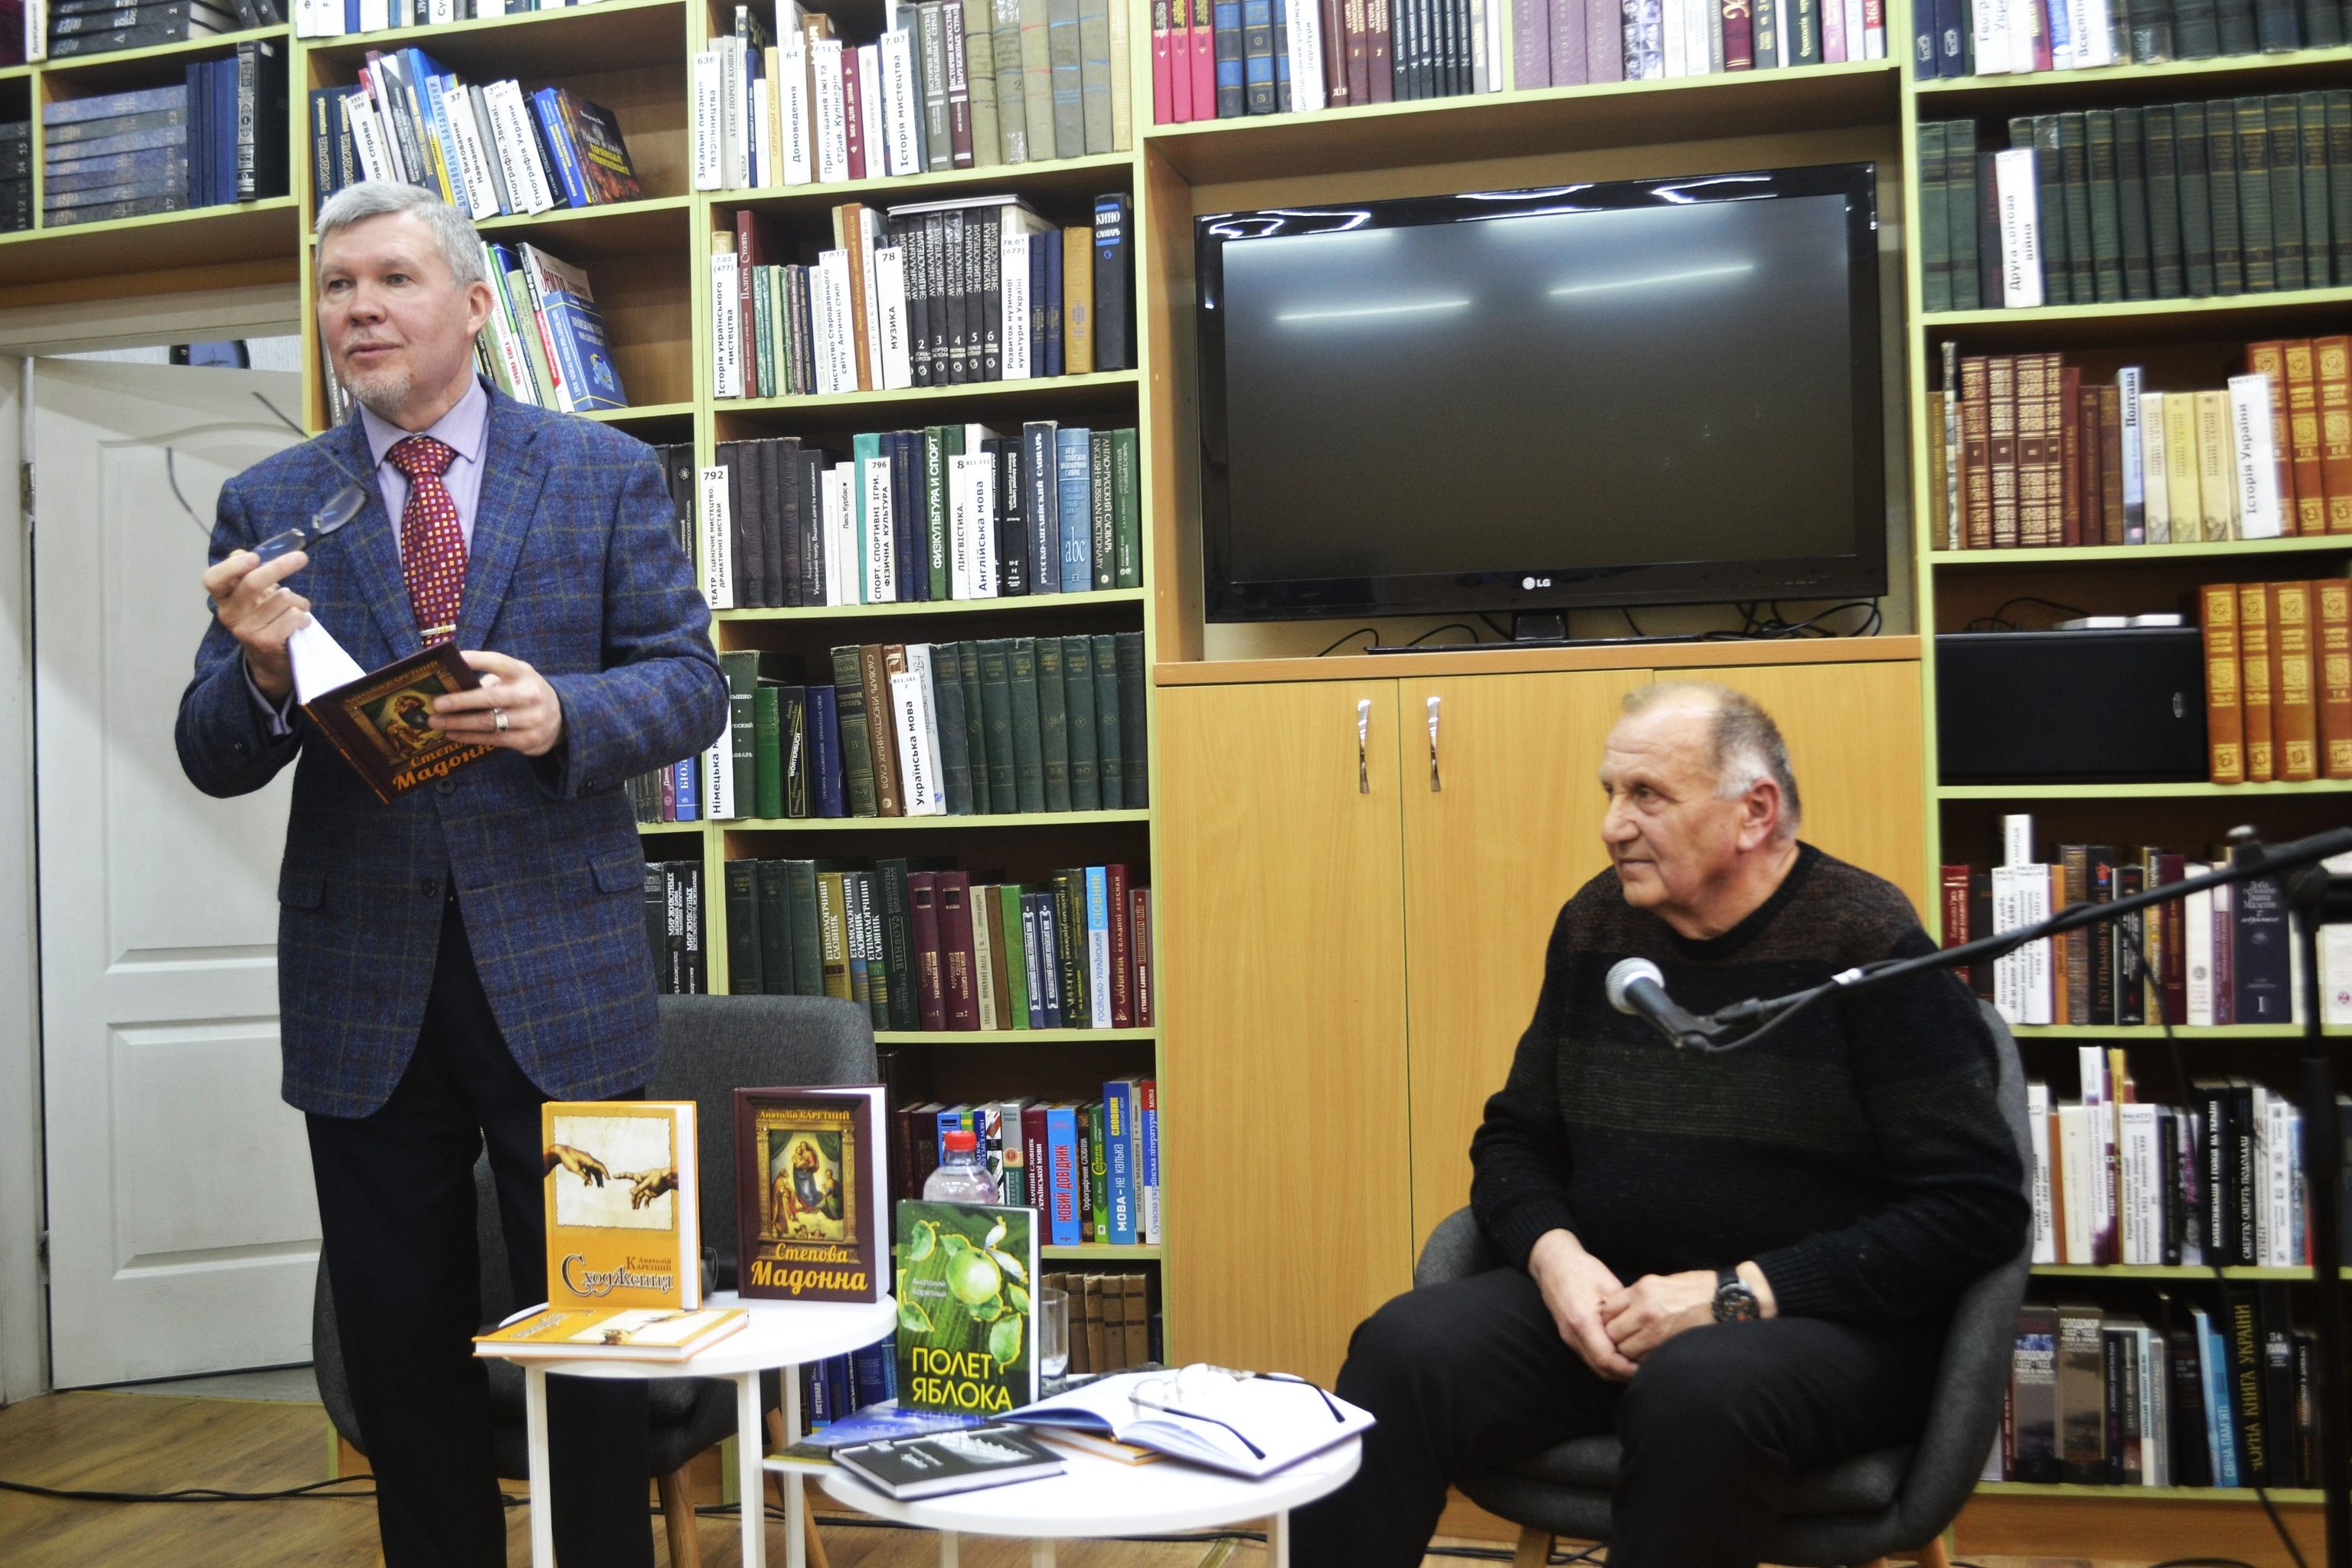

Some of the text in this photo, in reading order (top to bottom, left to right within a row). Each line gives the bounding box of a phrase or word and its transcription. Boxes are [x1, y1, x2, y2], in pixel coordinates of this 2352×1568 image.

[697, 56, 715, 64] 636
[786, 51, 798, 59] 64
[885, 35, 905, 45] 7.03
[821, 65, 827, 75] та
[430, 82, 450, 139] БАТАЛЬЙОНИ
[450, 93, 460, 103] 37
[894, 55, 909, 167] Історія мистецтва
[362, 120, 377, 158] справа
[792, 86, 802, 162] Домоведення
[823, 99, 833, 175] Приготування
[318, 136, 330, 191] ЮРИДИЧНА
[453, 119, 479, 210] Освіта. Виховання.
[467, 136, 483, 184] Навчання
[501, 144, 522, 207] Етнографія.
[508, 105, 543, 207] Етнографія України
[1096, 211, 1120, 225] КИНО
[882, 253, 895, 262] 78
[908, 232, 918, 299] МУЗЫКАЛЬНАЯ
[916, 231, 926, 299] ЭНЦИКЛОПЕДИЯ
[926, 229, 936, 296] МУЗЫКАЛЬНАЯ
[934, 228, 944, 296] ЭНЦИКЛОПЕДИЯ
[946, 228, 955, 296] МУЗЫКАЛЬНАЯ
[955, 228, 963, 296] ЭНЦИКЛОПЕДИЯ
[2004, 195, 2020, 290] Друга світова
[714, 264, 733, 273] (477)
[717, 282, 726, 354] українського
[824, 270, 840, 391] Мистецтво Стародавнього
[888, 307, 897, 349] МУЗИКА
[936, 335, 942, 345] 3
[955, 335, 961, 345] 4
[971, 332, 978, 342] 5
[988, 331, 994, 341] 6
[919, 339, 925, 349] 2
[2125, 372, 2136, 428] Полтава
[704, 471, 724, 480] 792
[957, 461, 965, 469] 8
[2237, 403, 2256, 514] Історія України
[929, 436, 942, 569] ФИЗКУЛЬТУРА И СПОРТ
[977, 518, 988, 591] Англійська
[1065, 526, 1086, 563] abc
[1104, 513, 1112, 553] СЛОВАРЬ
[1537, 579, 1551, 587] LG
[867, 654, 889, 789] СЛОВАРЬ ИНОСТРАННЫХ СЛОВ
[906, 701, 925, 805] Українська мова
[819, 881, 833, 960] ЕТИМОЛОГІЧНИЙ
[844, 879, 858, 958] ЕТИМОЛОГІЧНИЙ
[861, 880, 874, 960] ЕТИМОЛОГІЧНИЙ
[1092, 875, 1102, 927] СЛОВНИК
[831, 915, 841, 960] СЛОВНИК
[854, 913, 866, 958] СЛОВНИК
[873, 915, 883, 960] СЛОВНИК
[892, 916, 904, 971] СЛОВНИК
[2099, 936, 2108, 986] ГЕТЬМАНИ
[760, 1110, 851, 1120] Анатолій КАРЕТНИЙ
[1148, 1109, 1157, 1156] літературна
[2209, 1101, 2217, 1132] УКРАЇНІ
[2210, 1134, 2218, 1145] НА
[2210, 1148, 2219, 1174] ГОЛОД
[1054, 1145, 1073, 1223] НОВИЙ ДОВІДНИК
[1114, 1144, 1127, 1231] МОВА не калька
[1150, 1158, 1158, 1201] українська
[2240, 1135, 2251, 1259] СМЕРТЮ СМЕРТЬ ПОДОЛАЛИ
[1150, 1202, 1158, 1235] Сучасна
[561, 1252, 674, 1298] Сходження
[775, 1242, 849, 1263] Степова
[750, 1261, 869, 1295] Мадонна
[912, 1278, 946, 1288] Анатолий
[912, 1288, 947, 1298] Каретный
[2234, 1304, 2255, 1364] УКРАЇНИ
[913, 1348, 993, 1380] ПОЛЕТ
[913, 1377, 1014, 1410] ЯБЛОКА
[2239, 1370, 2259, 1416] КНИГА
[2223, 1448, 2235, 1477] СВІЧА
